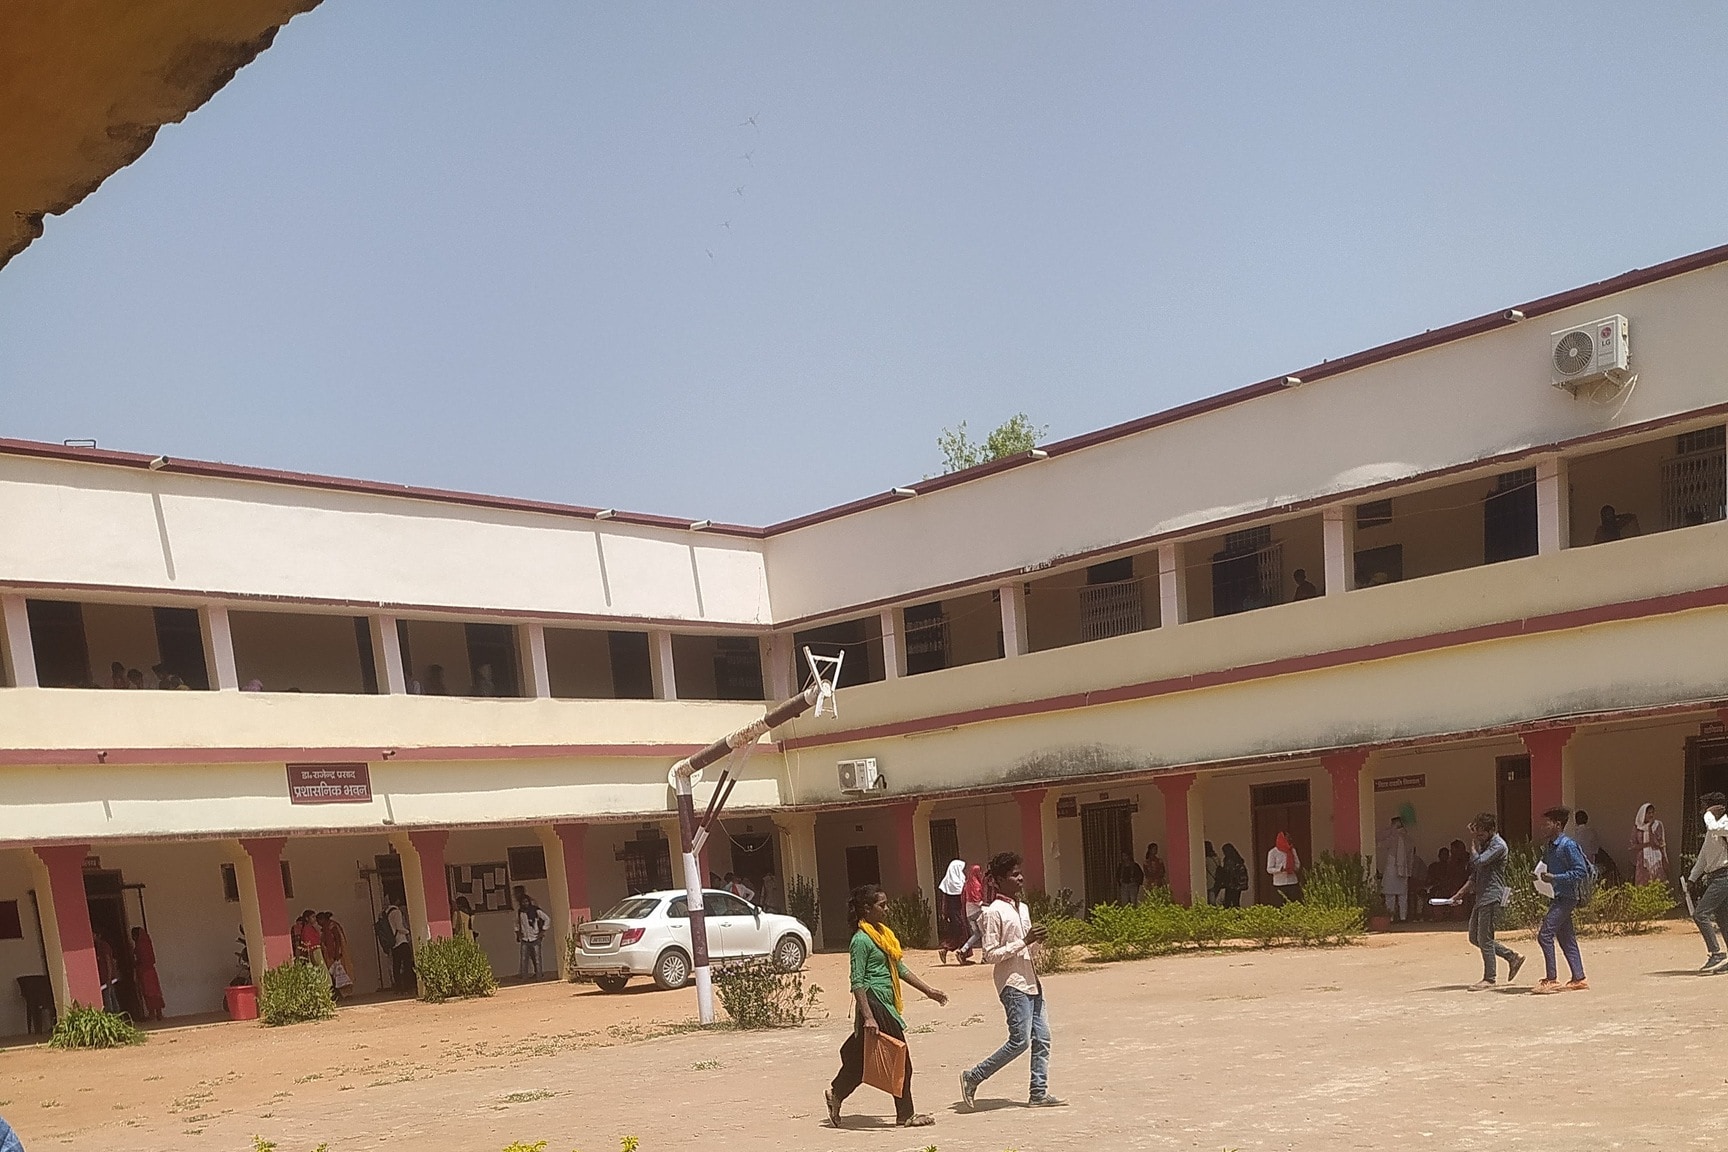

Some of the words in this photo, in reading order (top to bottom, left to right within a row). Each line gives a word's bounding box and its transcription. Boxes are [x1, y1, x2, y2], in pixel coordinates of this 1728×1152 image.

[1601, 339, 1611, 347] LG
[336, 770, 356, 779] प्रसाद
[293, 781, 342, 798] प्रशासनिक
[343, 784, 368, 796] भवन
